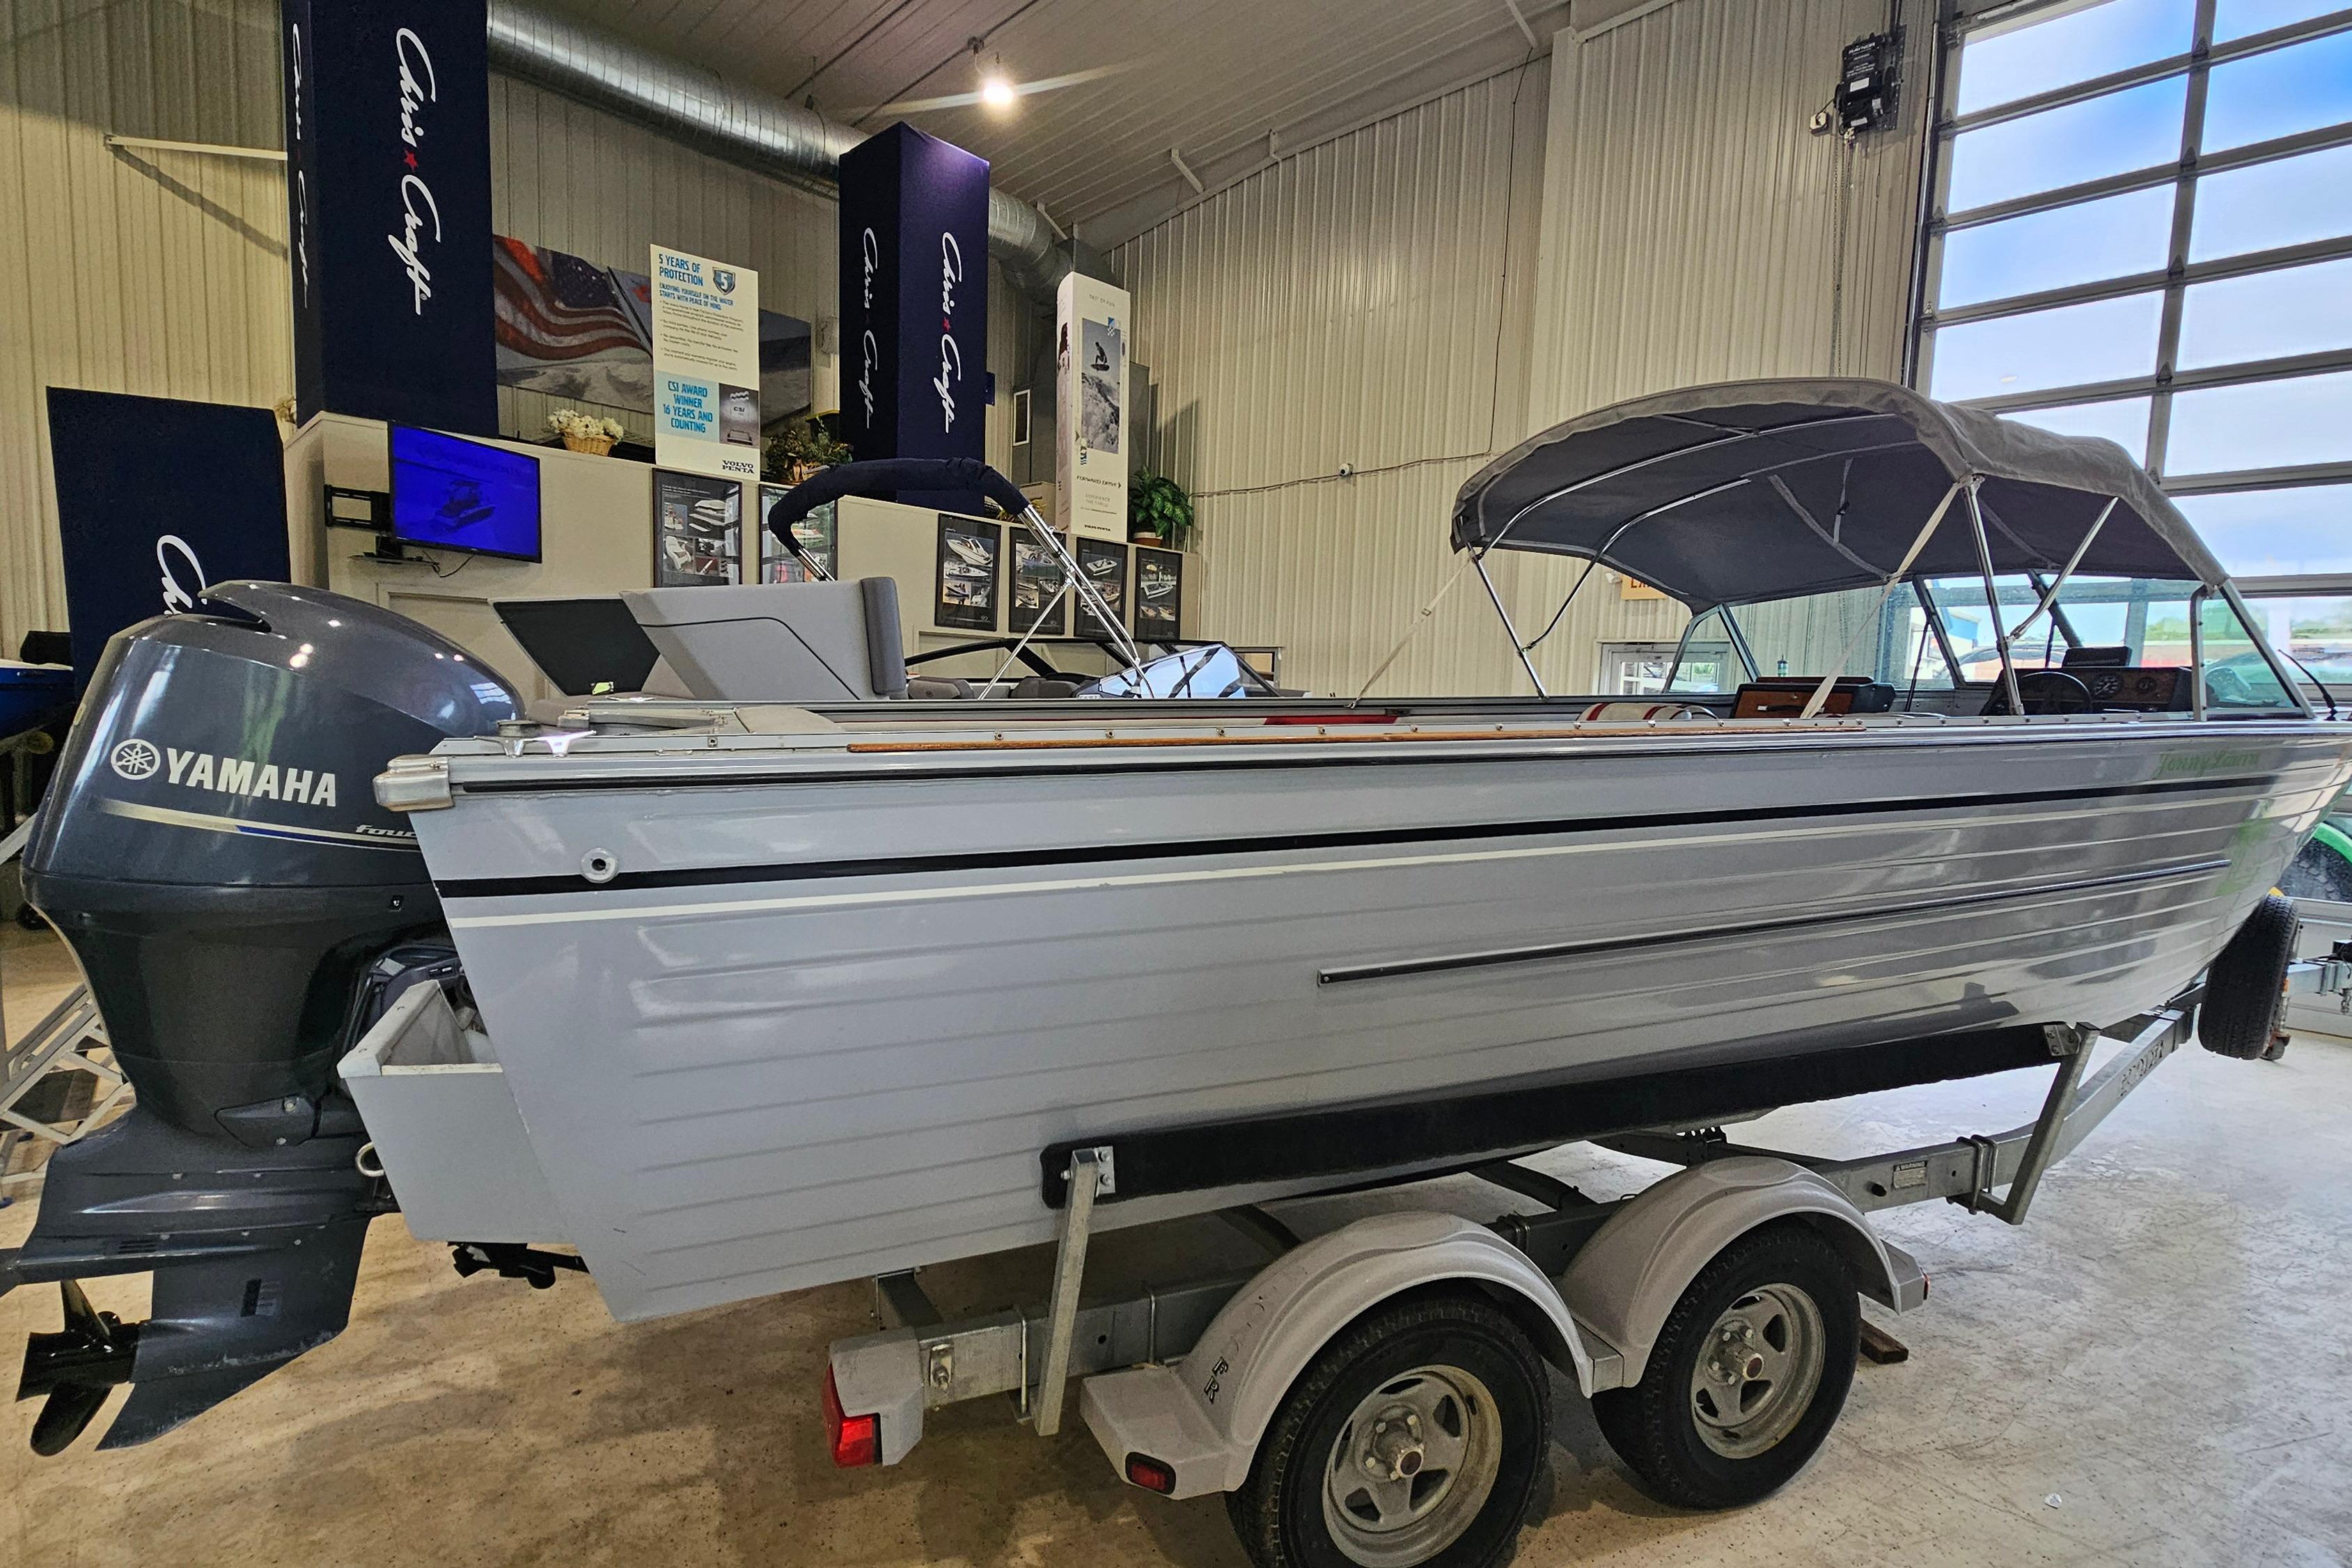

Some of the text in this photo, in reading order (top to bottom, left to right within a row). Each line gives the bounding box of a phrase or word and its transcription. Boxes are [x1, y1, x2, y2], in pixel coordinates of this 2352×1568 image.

[395, 27, 436, 148] Chris
[659, 253, 701, 273] 5 YEARS OF
[863, 227, 878, 309] Chris
[659, 266, 704, 287] PROTECTION
[942, 231, 962, 315] Chris
[659, 290, 676, 300] STARTS
[676, 294, 689, 302] WITH
[689, 297, 702, 306] PEACE
[681, 287, 702, 298] YOURSELF
[709, 295, 719, 303] THE
[719, 297, 734, 306] WATER
[668, 380, 707, 398] CSI AWARD
[673, 394, 703, 409] WINNER
[663, 404, 713, 423] 16 YEARS AND
[671, 418, 706, 433] COUNTING
[722, 460, 753, 469] VOLVO
[722, 464, 755, 474] PENTA
[166, 747, 337, 807] YAMAHA
